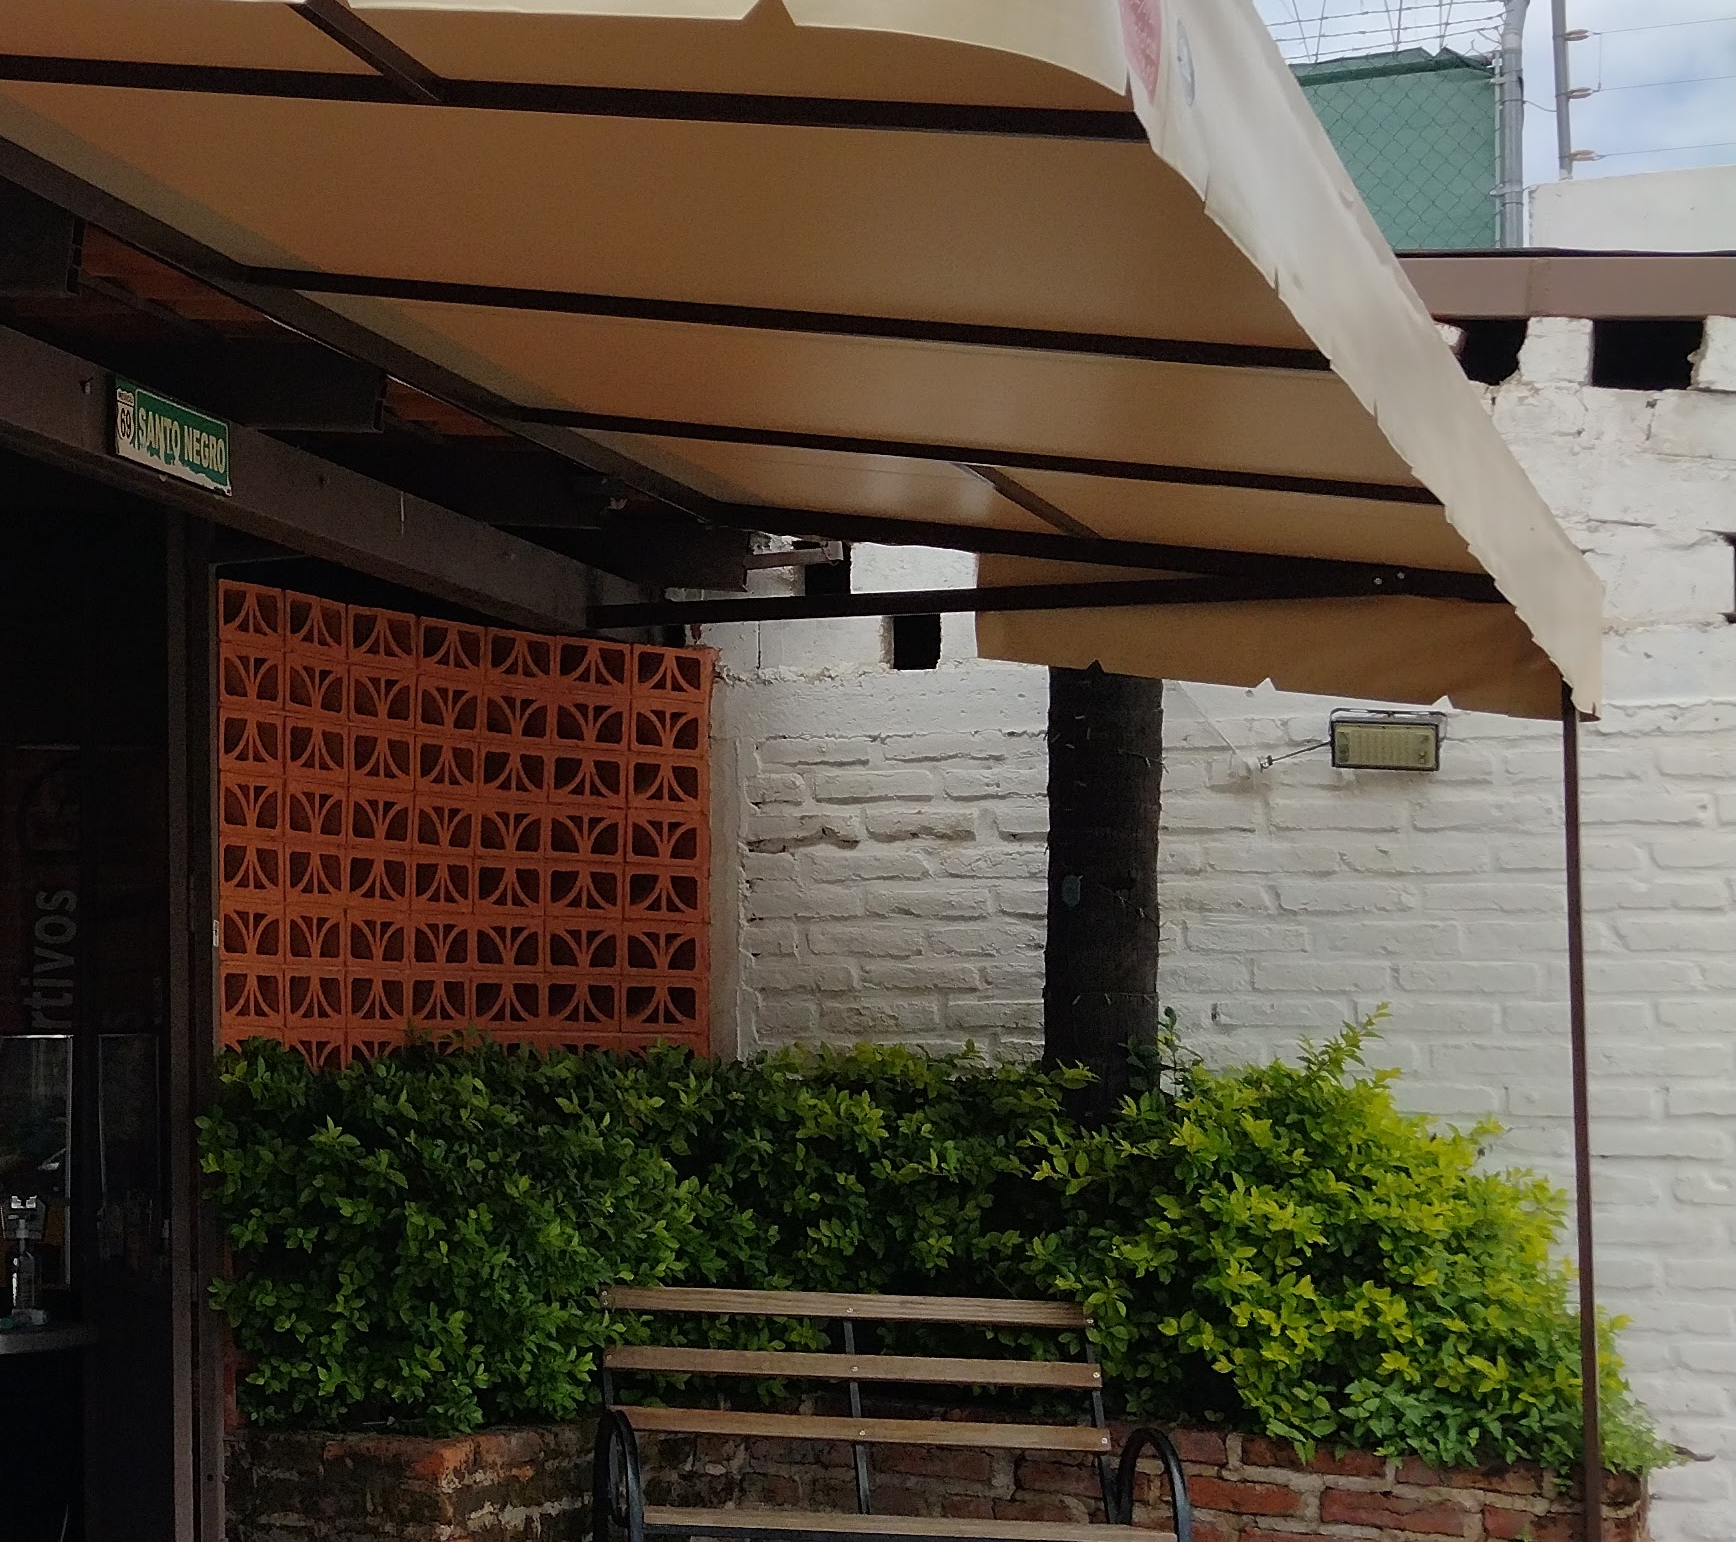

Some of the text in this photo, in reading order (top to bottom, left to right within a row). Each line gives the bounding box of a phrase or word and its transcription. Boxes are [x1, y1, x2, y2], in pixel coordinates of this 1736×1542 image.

[120, 407, 132, 439] 69
[138, 407, 225, 473] SANTO NEGRO
